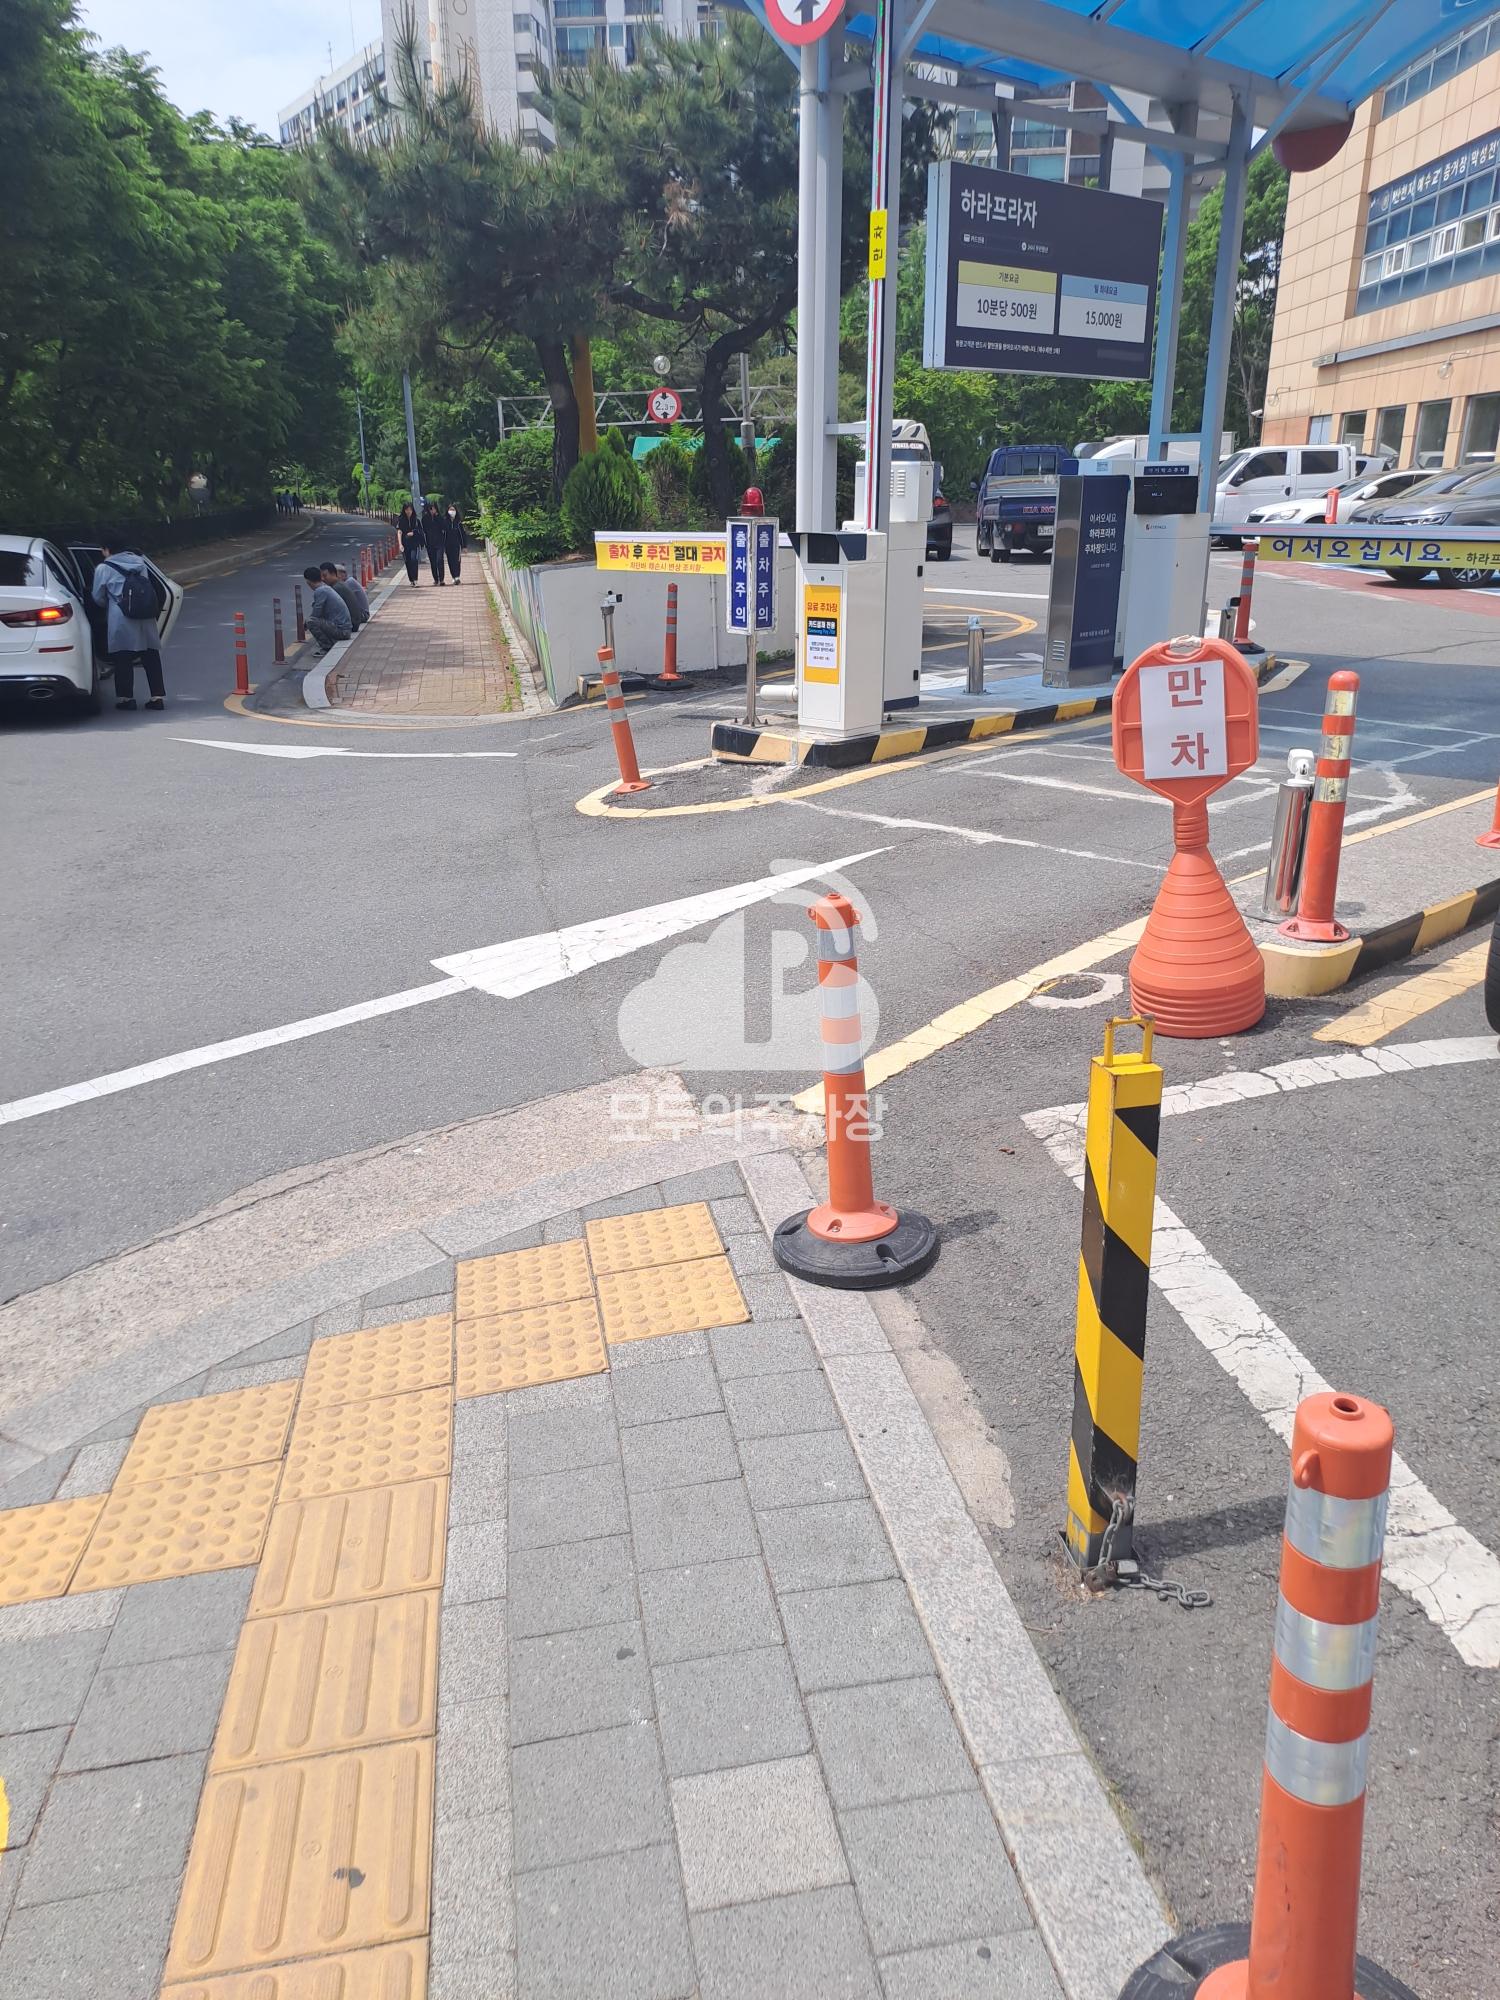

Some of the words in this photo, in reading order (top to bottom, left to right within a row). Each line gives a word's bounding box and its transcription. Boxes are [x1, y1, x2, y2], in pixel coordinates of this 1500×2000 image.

[960, 188, 1038, 229] 하라프라자
[998, 272, 1020, 284] 기본요금
[977, 298, 1008, 317] 10분당
[1010, 302, 1038, 320] 500원
[1085, 310, 1123, 329] 15,000원
[608, 543, 630, 560] 출차
[633, 543, 643, 560] 후
[646, 544, 670, 561] 후진
[673, 545, 698, 562] 절대
[701, 546, 726, 563] 금지
[1272, 538, 1450, 563] 어서오십시요.
[735, 530, 746, 623] 출차주의
[757, 531, 770, 623] 출차주의
[807, 601, 819, 612] 유료
[820, 602, 838, 613] 주차장
[1167, 667, 1210, 771] 만차
